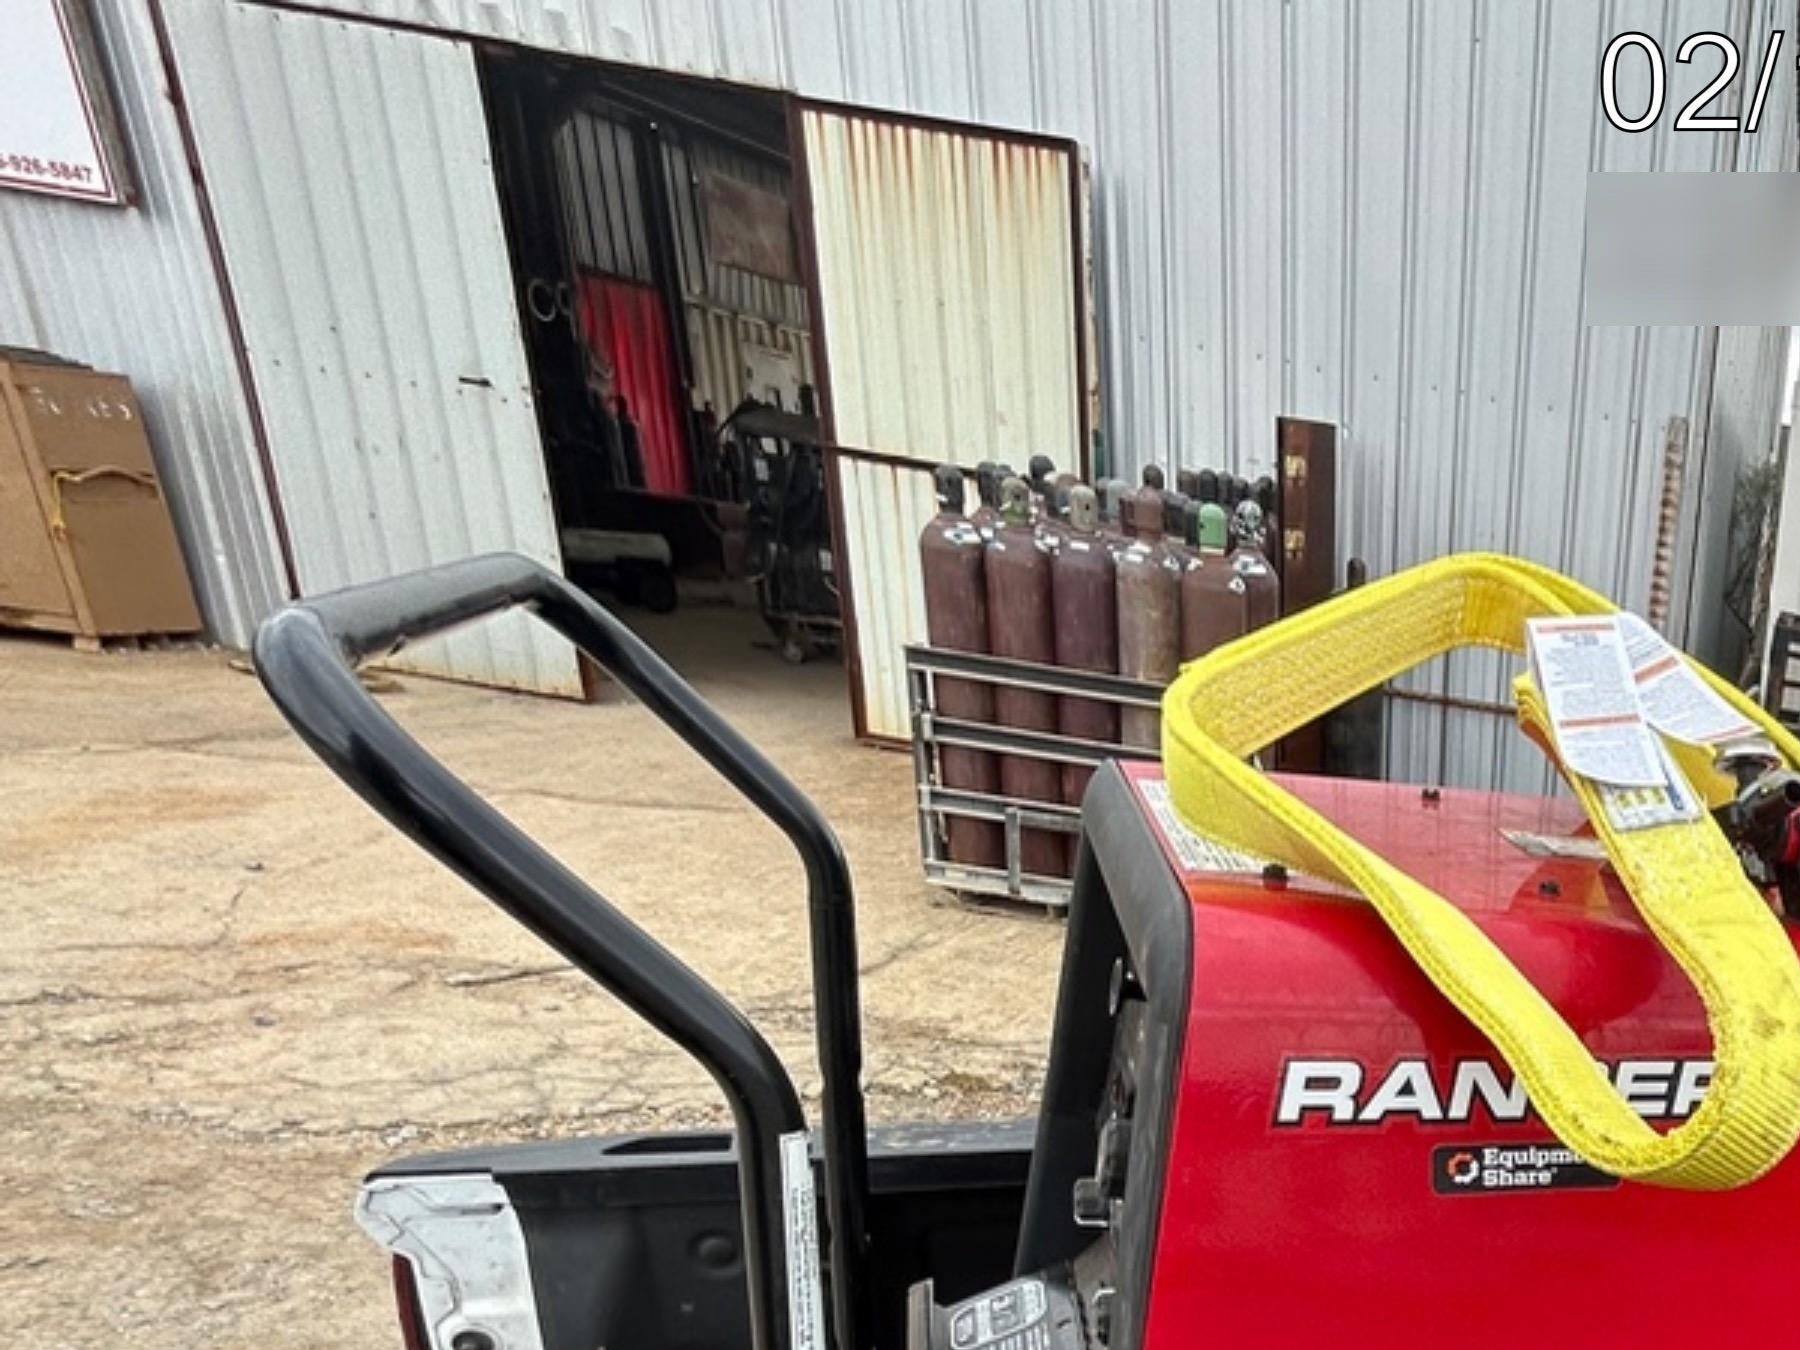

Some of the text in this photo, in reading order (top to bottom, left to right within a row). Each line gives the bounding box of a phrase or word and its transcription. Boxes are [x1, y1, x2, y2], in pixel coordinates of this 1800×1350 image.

[1276, 1060, 1716, 1123] RANE
[1482, 1145, 1588, 1168] Equipm
[1482, 1168, 1552, 1187] Share
